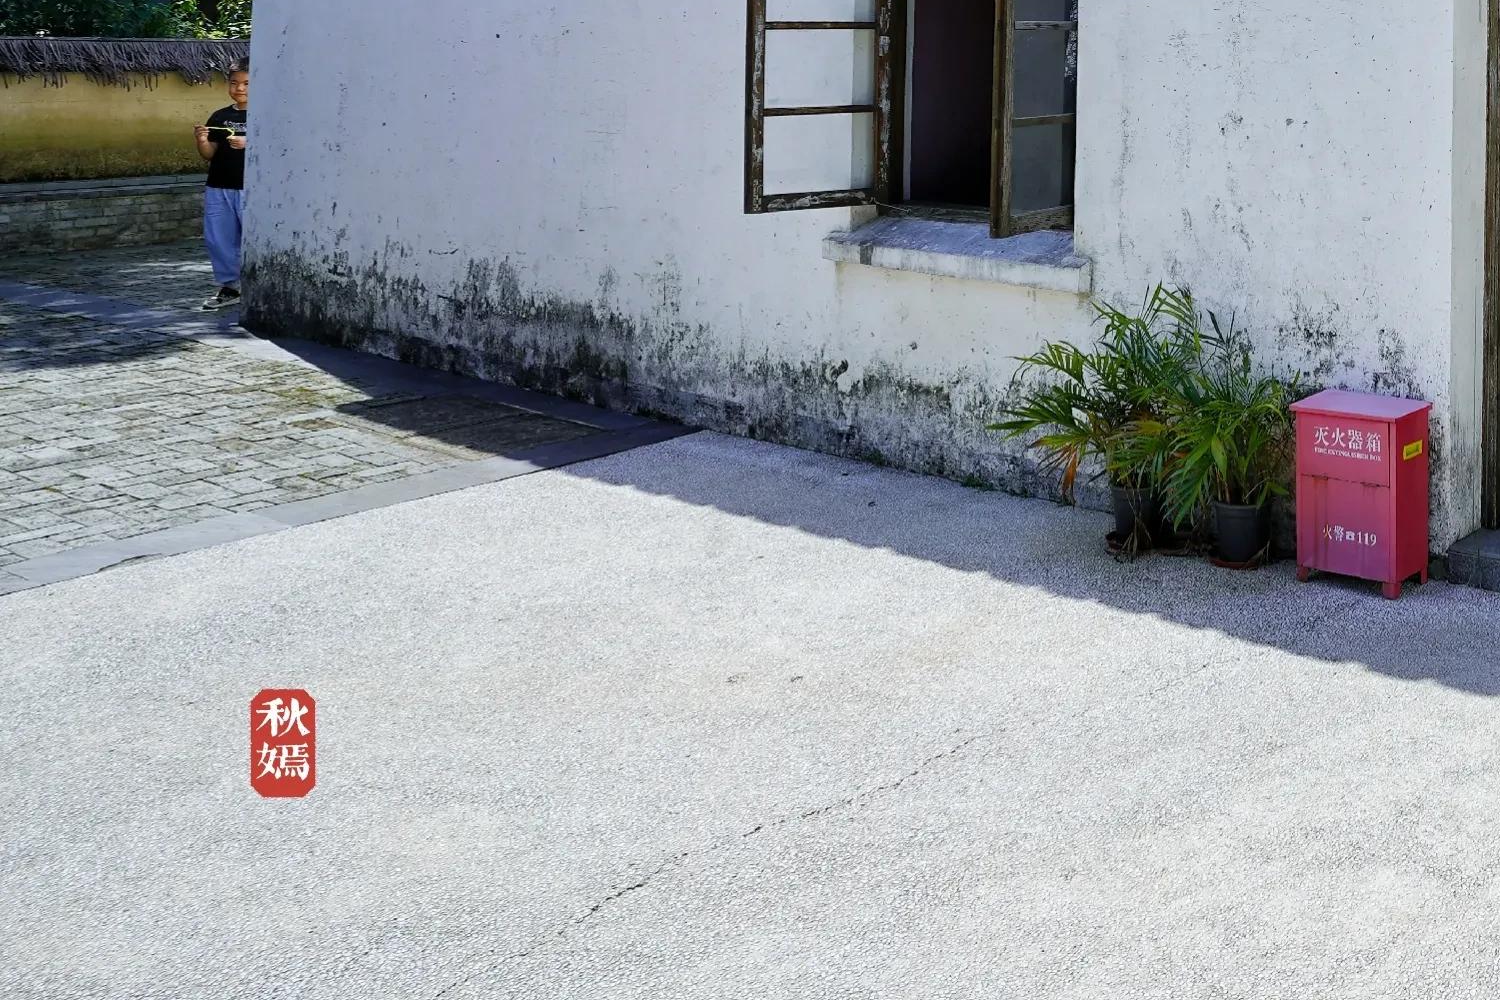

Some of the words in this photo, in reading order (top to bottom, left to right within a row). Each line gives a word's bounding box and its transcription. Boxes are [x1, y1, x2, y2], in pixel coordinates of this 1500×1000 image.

[1313, 426, 1381, 453] 灭火器箱
[1323, 524, 1345, 541] 火警
[1357, 531, 1377, 546] 119
